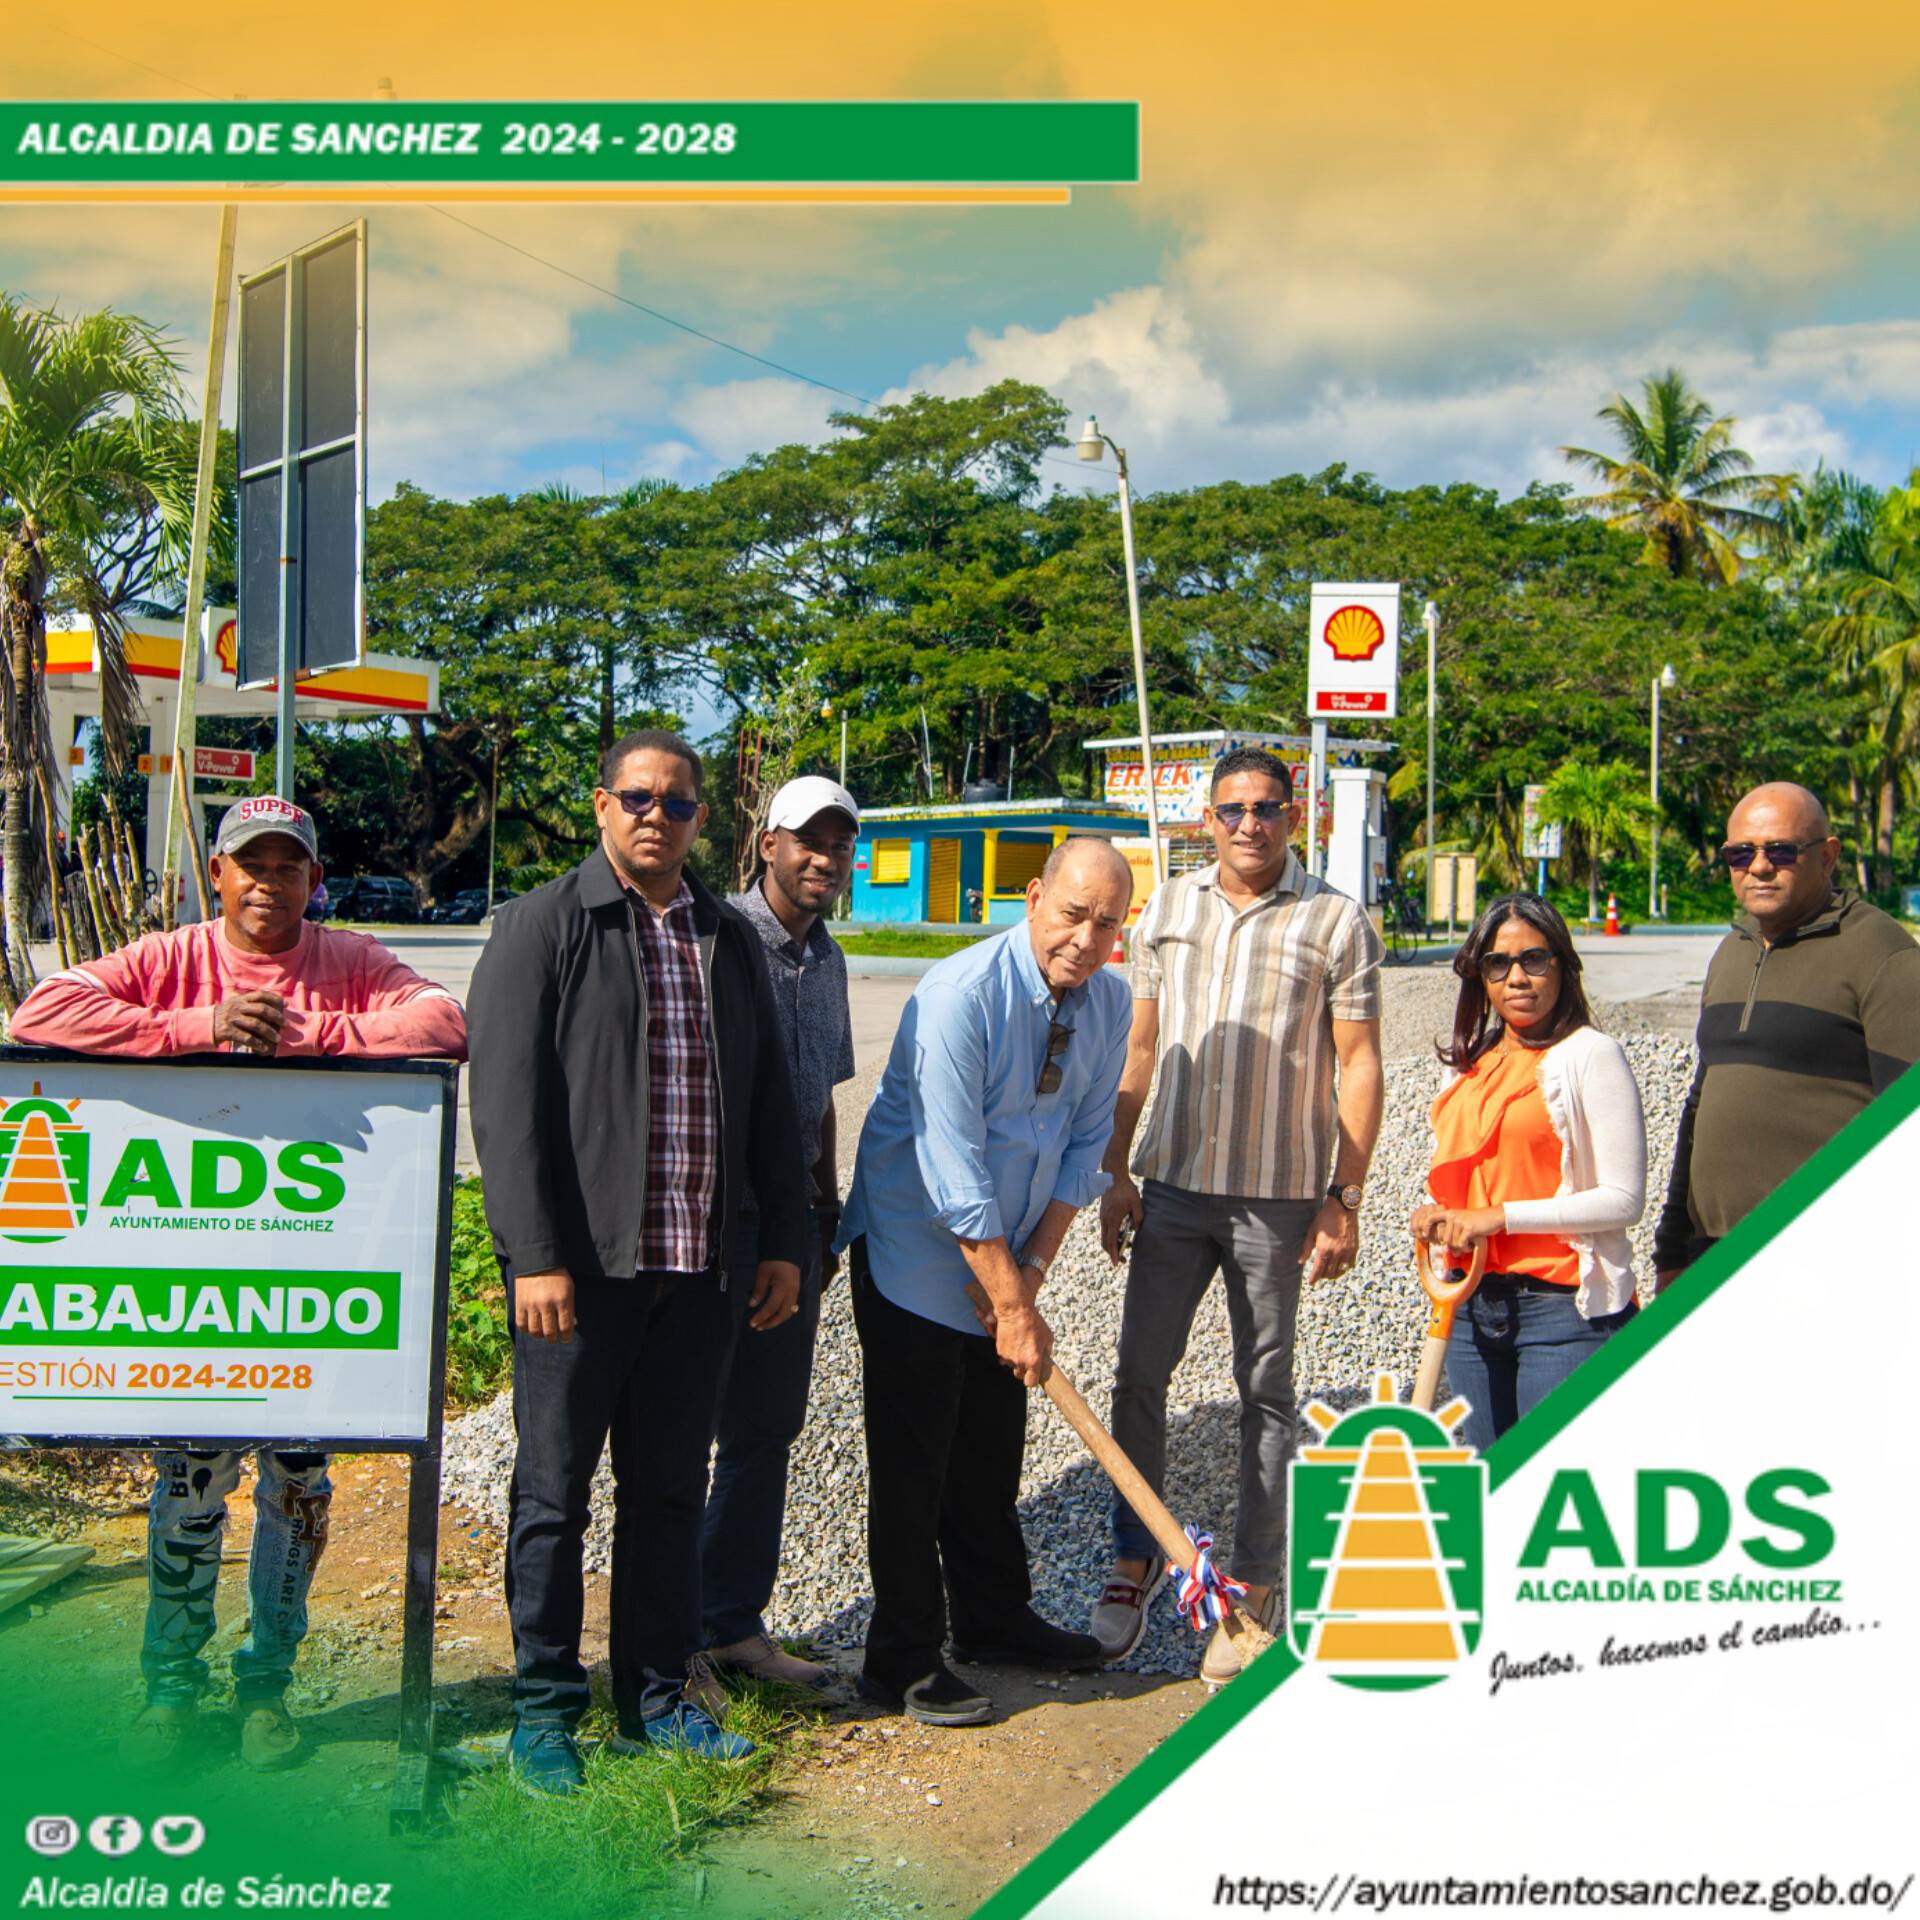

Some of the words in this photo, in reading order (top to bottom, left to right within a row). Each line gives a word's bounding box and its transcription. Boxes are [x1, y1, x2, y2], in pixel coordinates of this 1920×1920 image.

[1107, 763, 1190, 787] ERCK
[239, 798, 304, 826] SUPER
[99, 1138, 346, 1213] ADS
[109, 1216, 230, 1232] AYUNTAMIENTO
[234, 1218, 257, 1231] DE
[260, 1215, 335, 1233] SÁNCHEZ
[127, 1363, 314, 1390] 2024-2028
